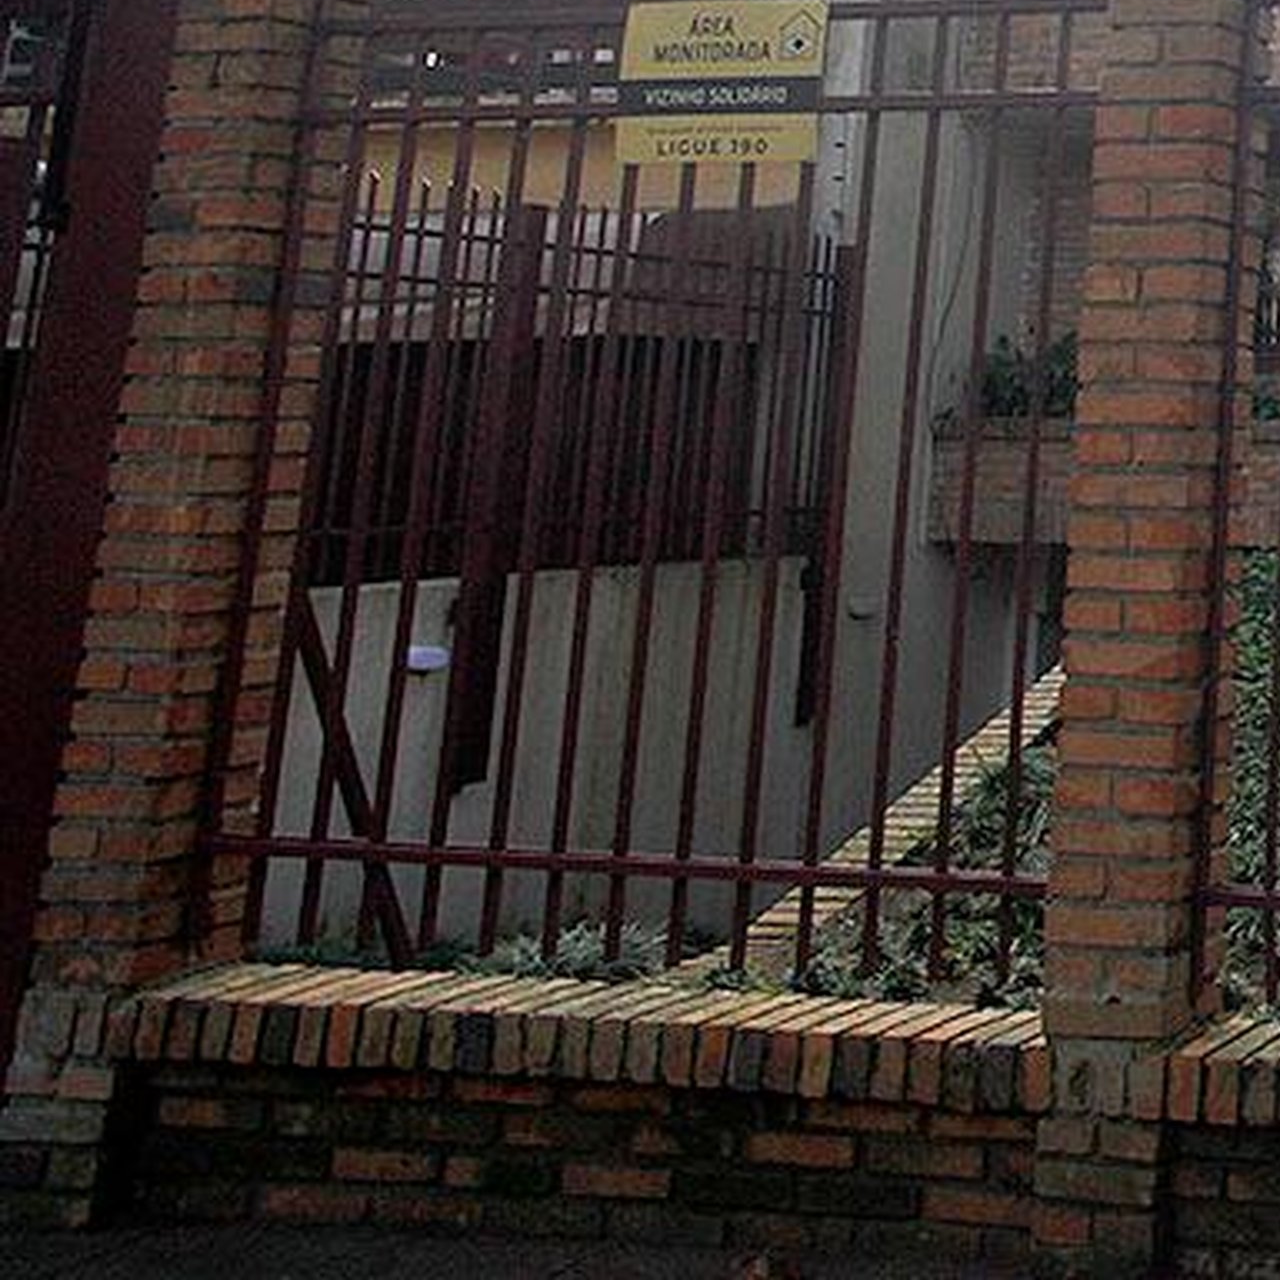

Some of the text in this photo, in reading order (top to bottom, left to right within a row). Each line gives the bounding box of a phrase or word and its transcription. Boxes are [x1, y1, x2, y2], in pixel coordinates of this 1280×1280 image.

[653, 39, 772, 63] MONITORADA
[656, 137, 768, 156] LIGUE 190
